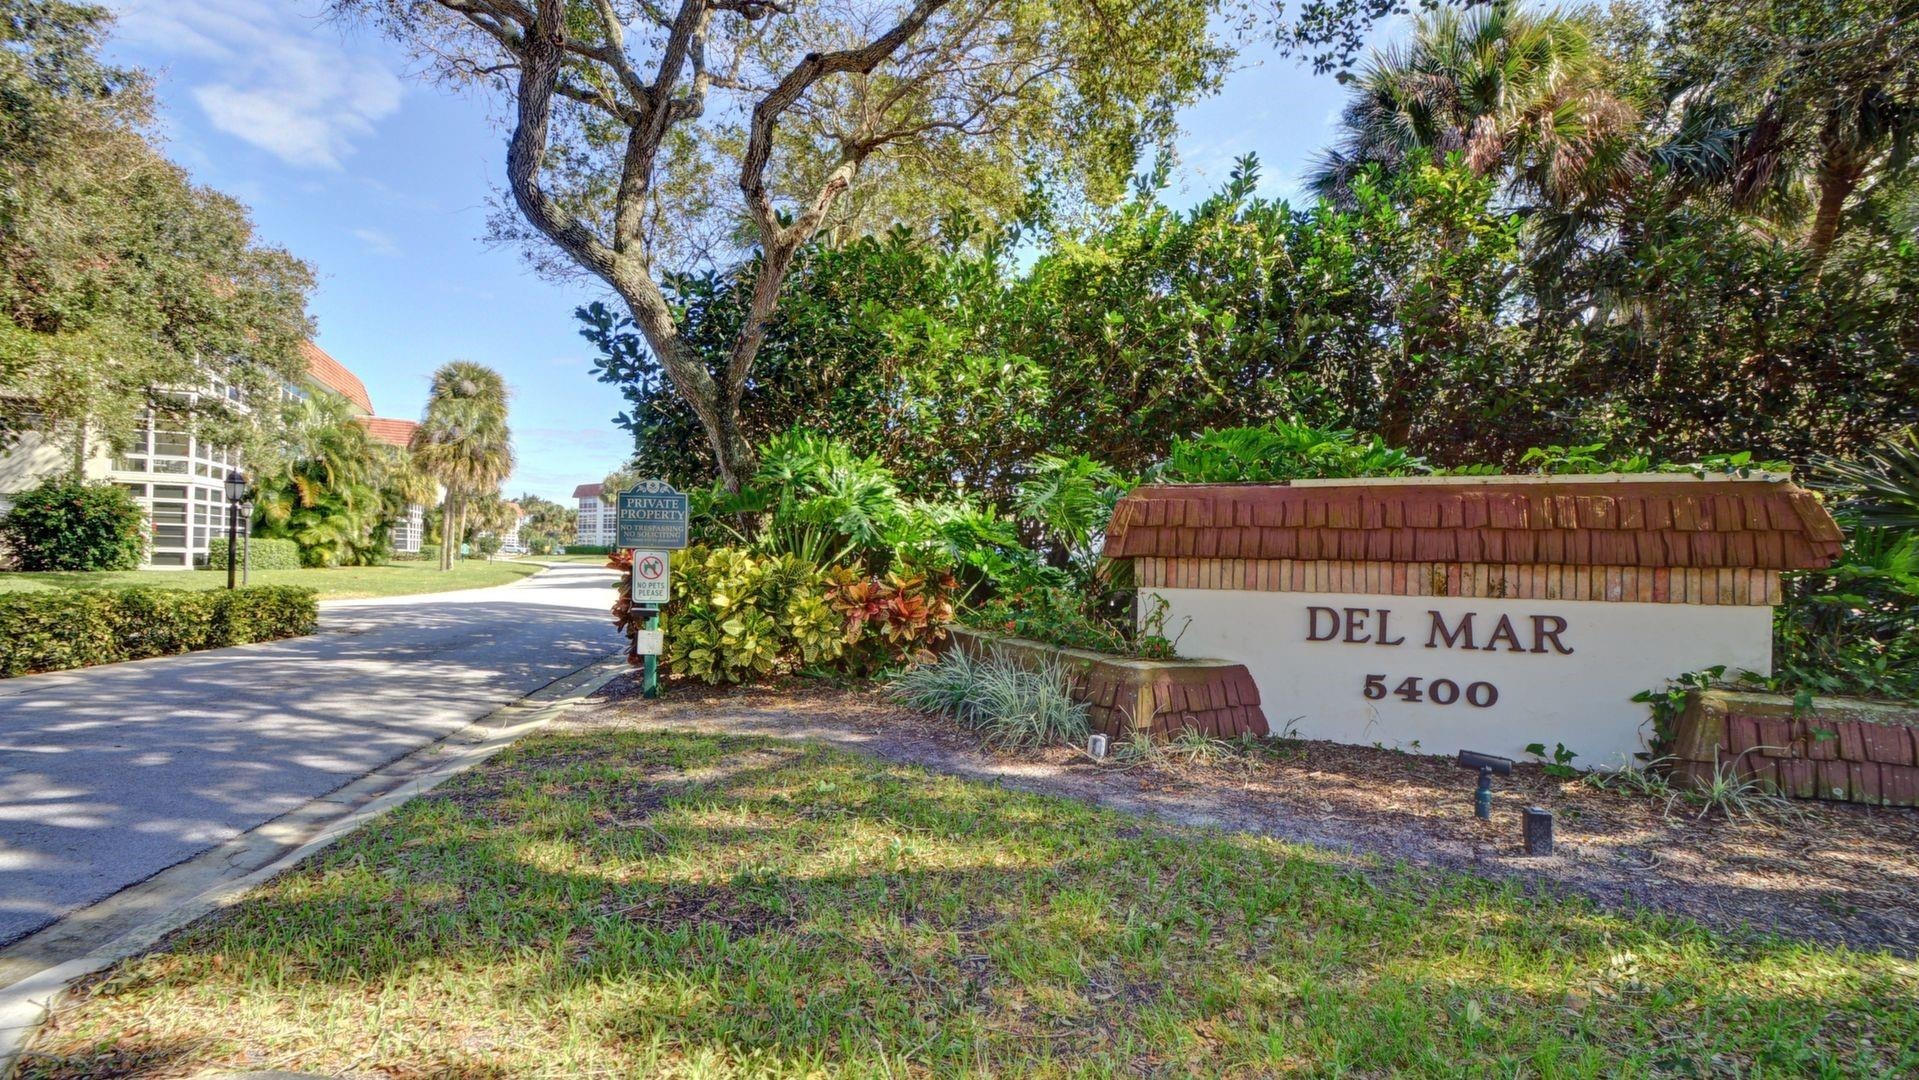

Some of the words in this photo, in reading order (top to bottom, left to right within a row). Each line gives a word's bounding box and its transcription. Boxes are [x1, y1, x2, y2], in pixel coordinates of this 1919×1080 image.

[620, 509, 685, 520] PROPERTY
[627, 498, 679, 509] PRIVATE
[1305, 606, 1405, 646] DEL
[1424, 610, 1574, 655] MAR
[1363, 674, 1499, 708] 5400
